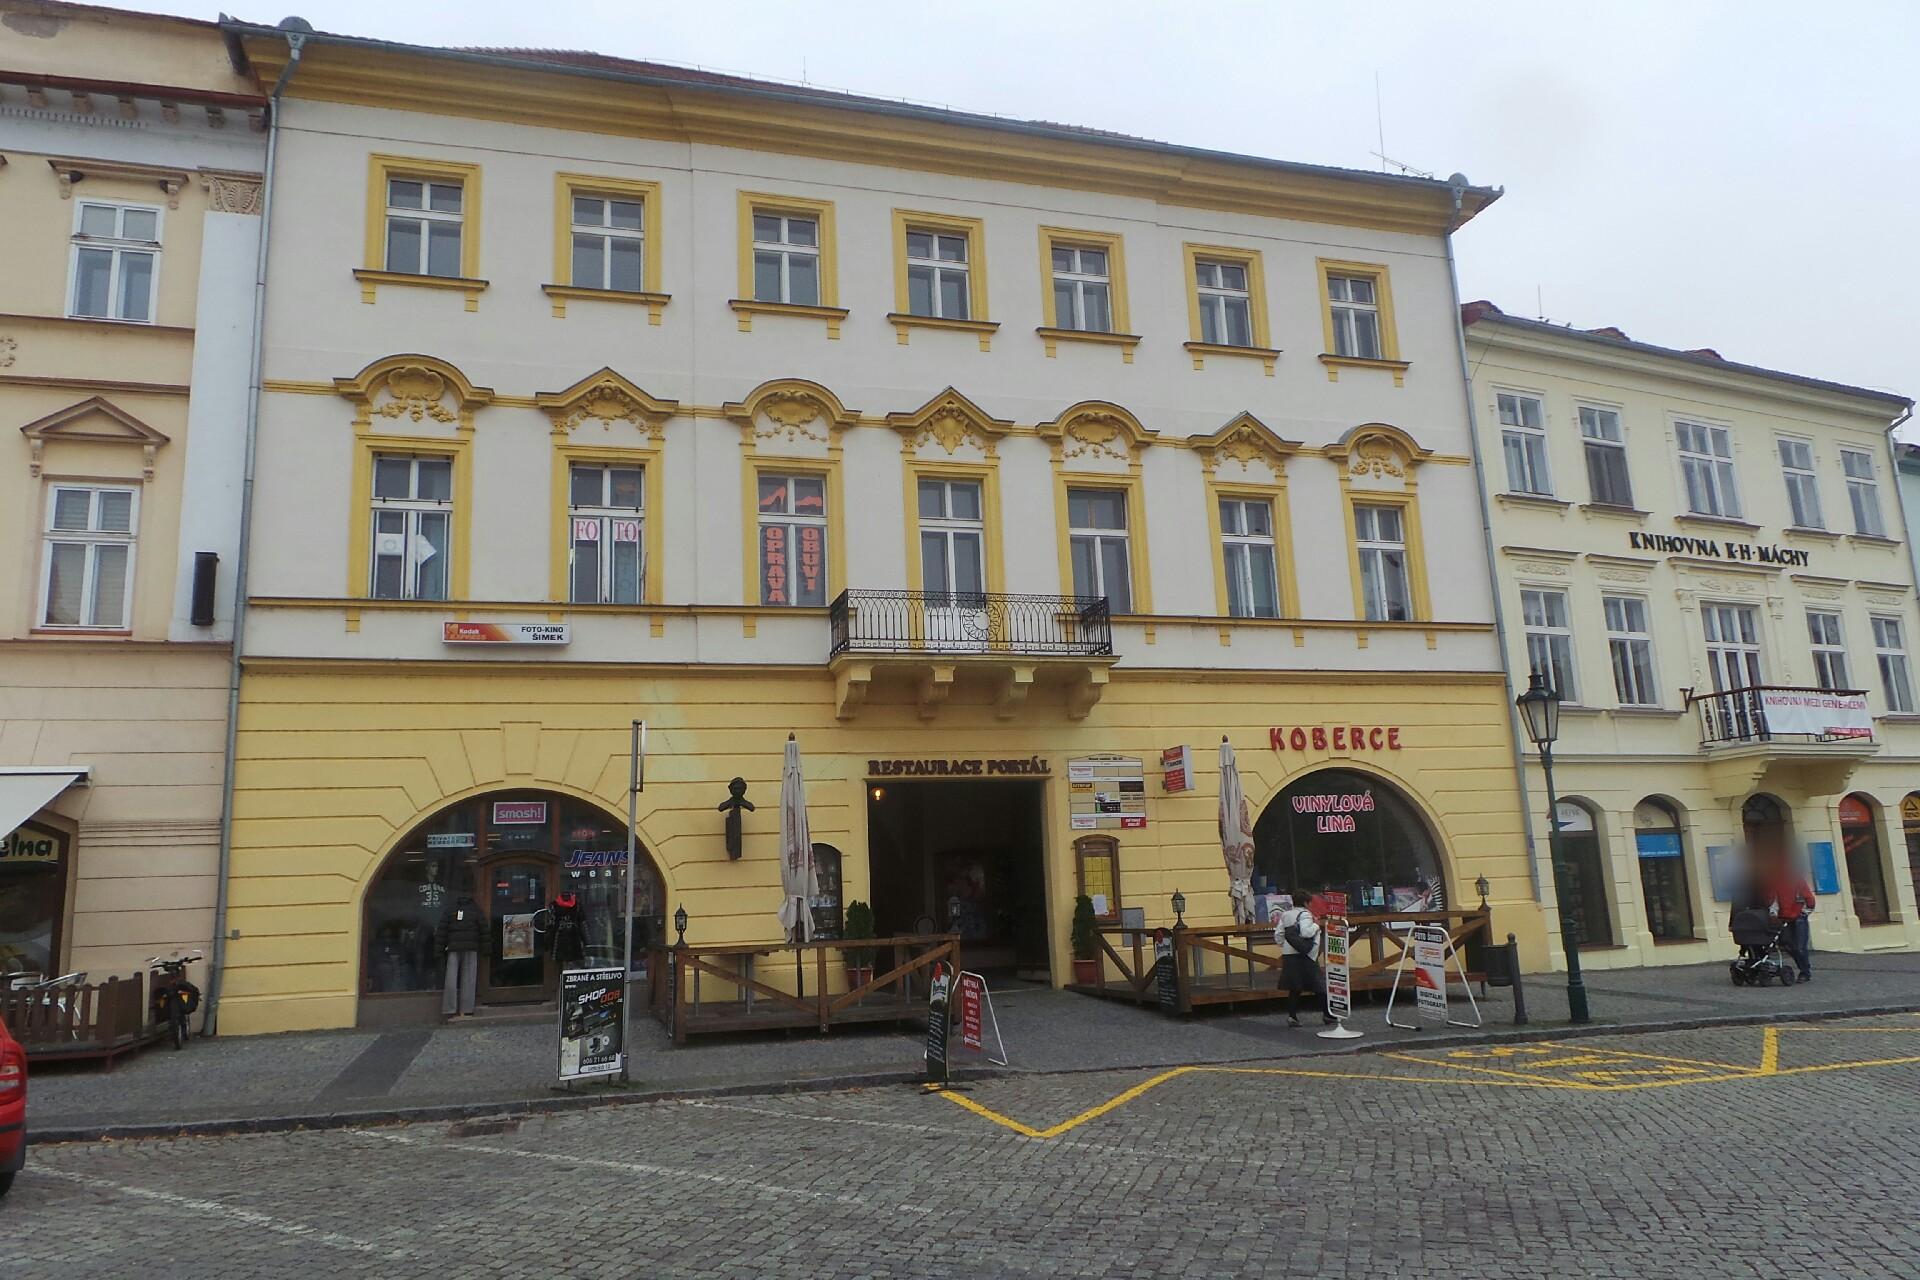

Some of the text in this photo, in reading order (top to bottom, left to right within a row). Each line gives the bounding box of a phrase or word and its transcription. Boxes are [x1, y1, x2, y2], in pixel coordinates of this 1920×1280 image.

[1629, 531, 1720, 557] KNIHOVNA
[1757, 544, 1809, 567] MÁCHY
[766, 527, 787, 603] OPRAVA
[532, 633, 564, 641] ŠIMEK
[1269, 727, 1402, 751] KOBERCE
[867, 756, 1052, 776] RESTAURACE PORTÁL
[1292, 790, 1375, 813] VINYLOVÁ
[499, 808, 541, 819] smash!
[1317, 815, 1356, 833] LINA
[565, 850, 629, 868] JEANS
[571, 869, 626, 878] wear
[1328, 937, 1345, 947] DIGI
[1328, 945, 1346, 955] FOTO
